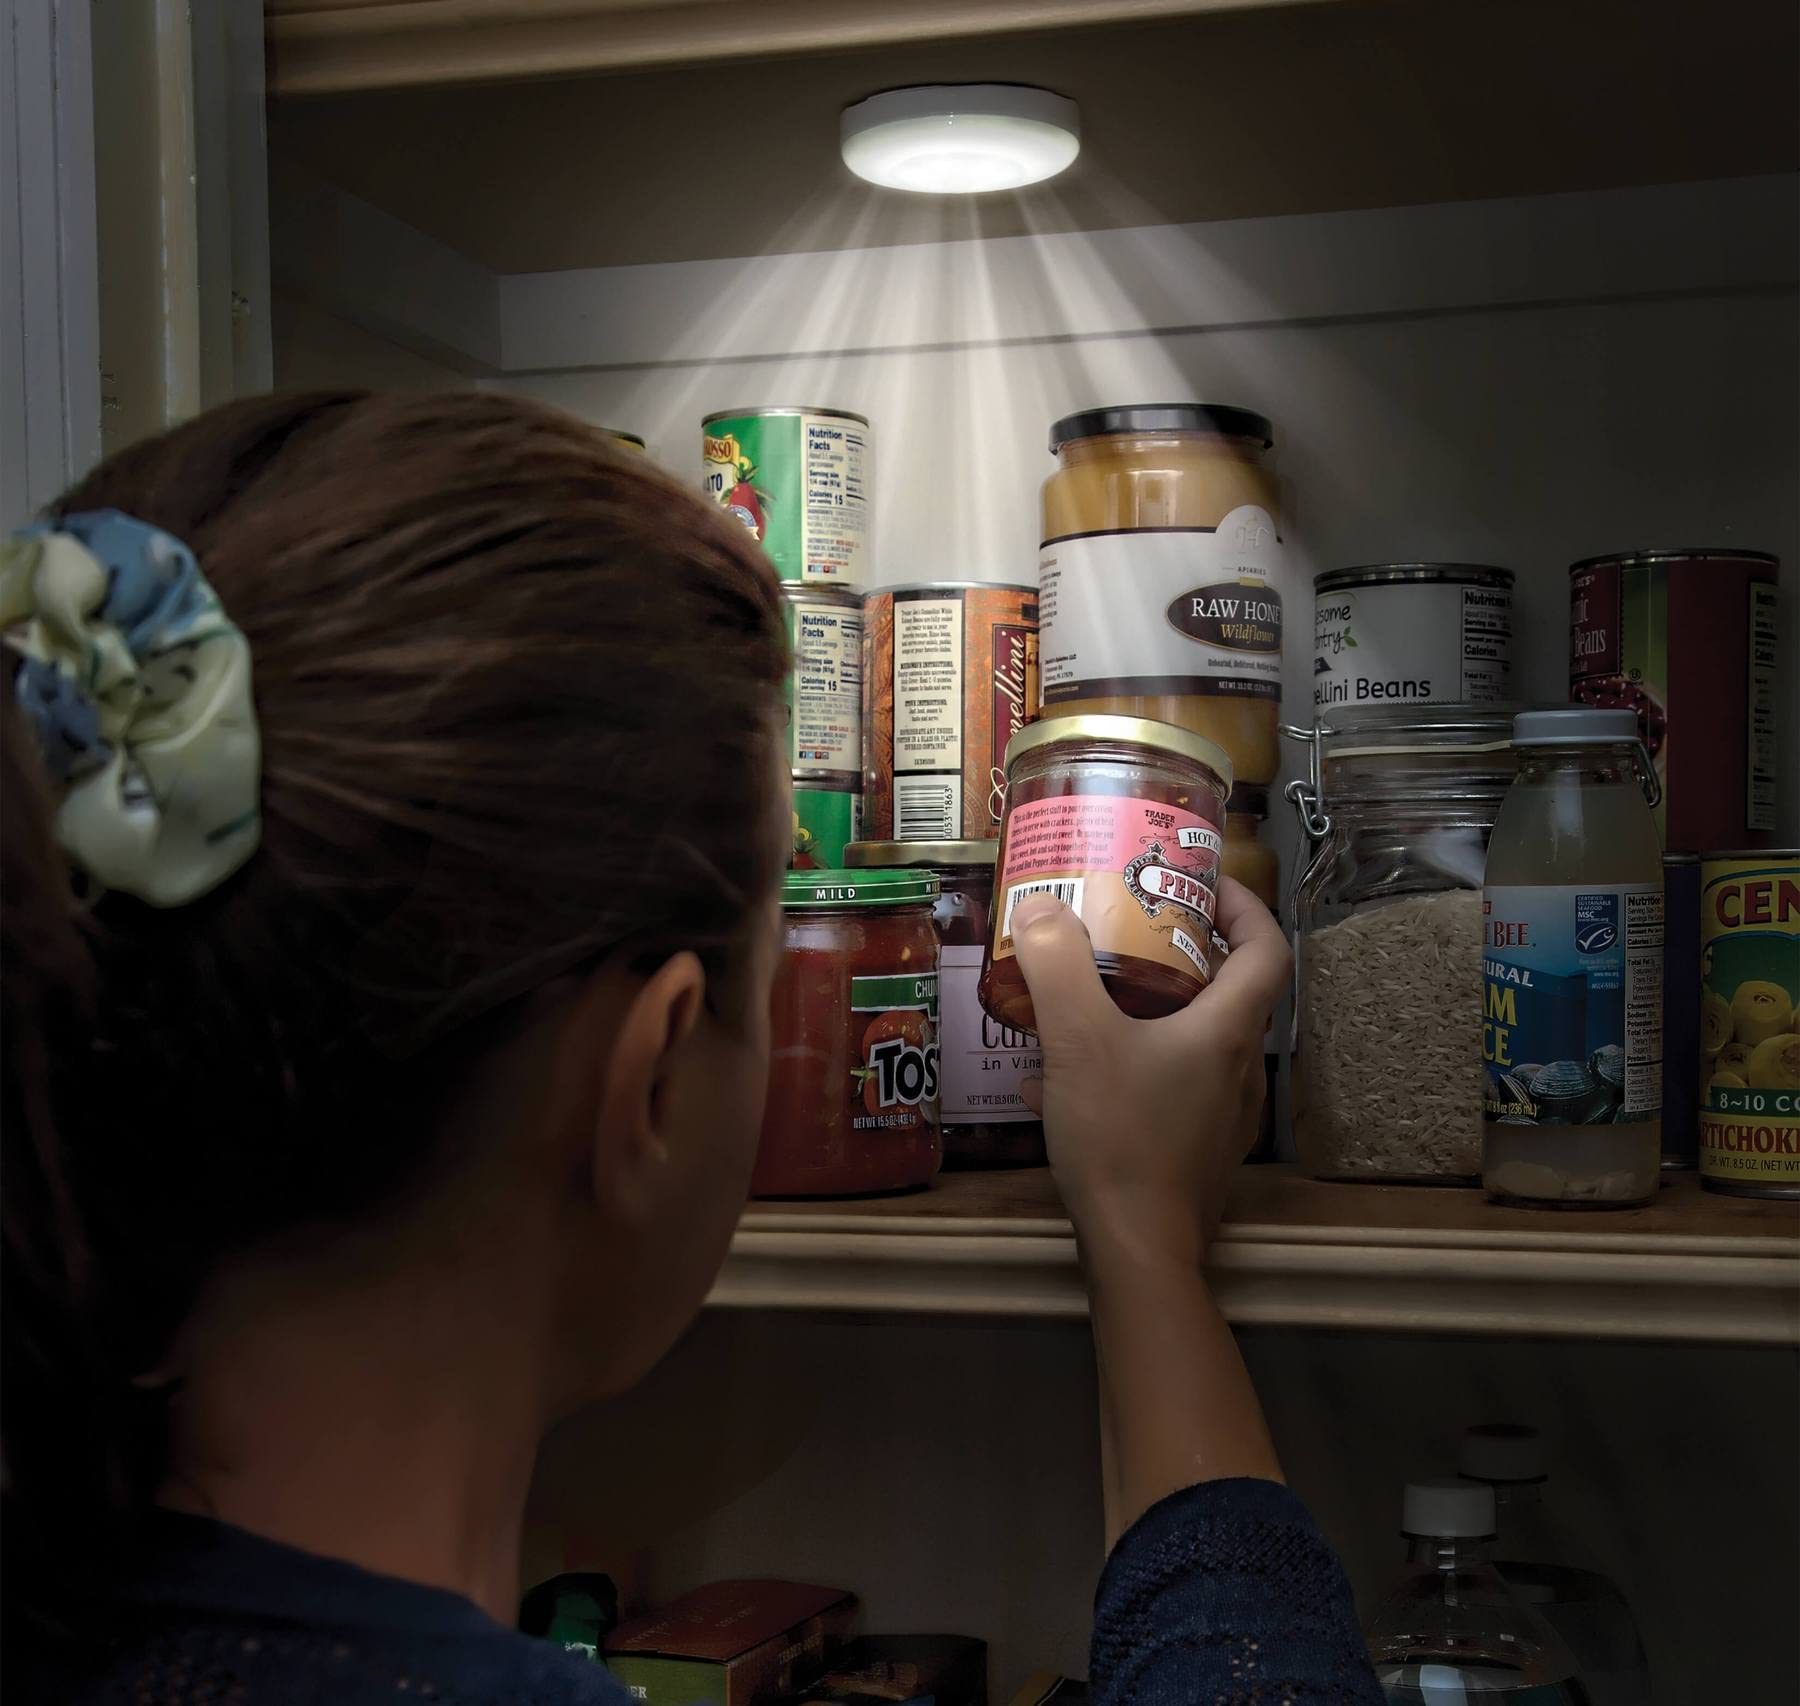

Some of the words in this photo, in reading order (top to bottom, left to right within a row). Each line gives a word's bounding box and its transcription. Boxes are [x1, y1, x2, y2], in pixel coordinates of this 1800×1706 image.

[809, 428, 842, 440] Nutrition
[809, 440, 831, 450] Facts
[809, 490, 832, 498] Calories
[834, 495, 843, 505] 15
[1238, 567, 1266, 575] APIARIES
[1192, 598, 1240, 618] RAW
[802, 615, 837, 626] Nutrition
[802, 627, 824, 638] Facts
[1220, 624, 1275, 644] Wildflower
[802, 676, 826, 685] Calories
[828, 680, 837, 691] 15
[1356, 678, 1431, 700] Beans
[944, 788, 954, 812] 1863
[1033, 808, 1049, 818] perfect
[1145, 810, 1175, 824] TRADER
[1148, 820, 1170, 829] JOE'S
[1037, 834, 1052, 843] plenty
[1188, 832, 1212, 844] HOT
[1048, 844, 1060, 854] salty
[1032, 858, 1048, 868] Pepper
[1050, 856, 1062, 866] Jelly
[816, 888, 856, 900] MILD
[1494, 920, 1530, 948] BEE
[1177, 935, 1194, 954] NET
[982, 1057, 1001, 1070] in
[967, 1096, 980, 1105] NET
[1720, 1092, 1766, 1111] 8~10
[1508, 1102, 1522, 1116] (236
[853, 1118, 866, 1130] NET
[878, 1116, 890, 1128] 15.5
[1761, 1160, 1782, 1172] (NET
[624, 1686, 647, 1698] ER
